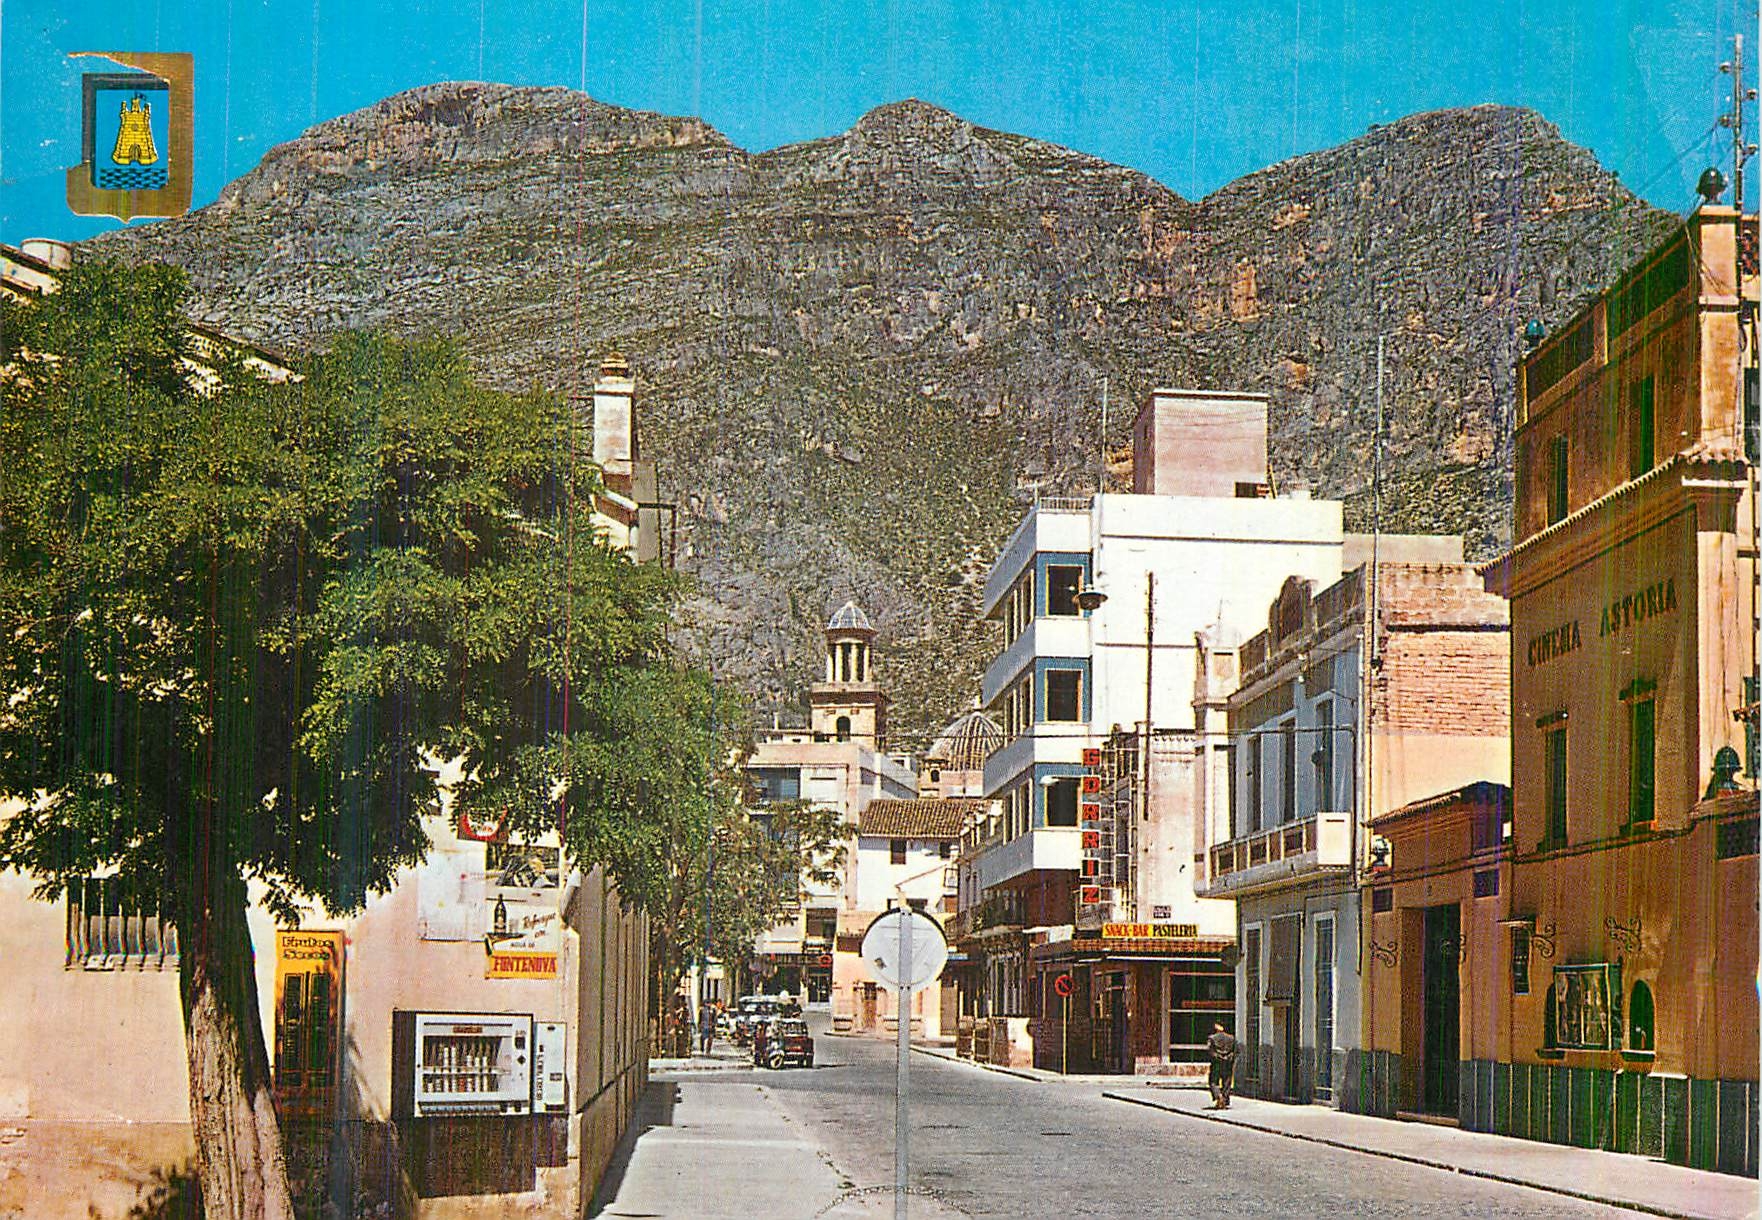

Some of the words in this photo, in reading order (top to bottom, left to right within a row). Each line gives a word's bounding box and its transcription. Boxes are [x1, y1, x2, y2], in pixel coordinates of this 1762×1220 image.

[1528, 619, 1582, 666] CINEMA
[1600, 577, 1677, 637] ASTORIA
[1152, 924, 1198, 938] PASTELERIA
